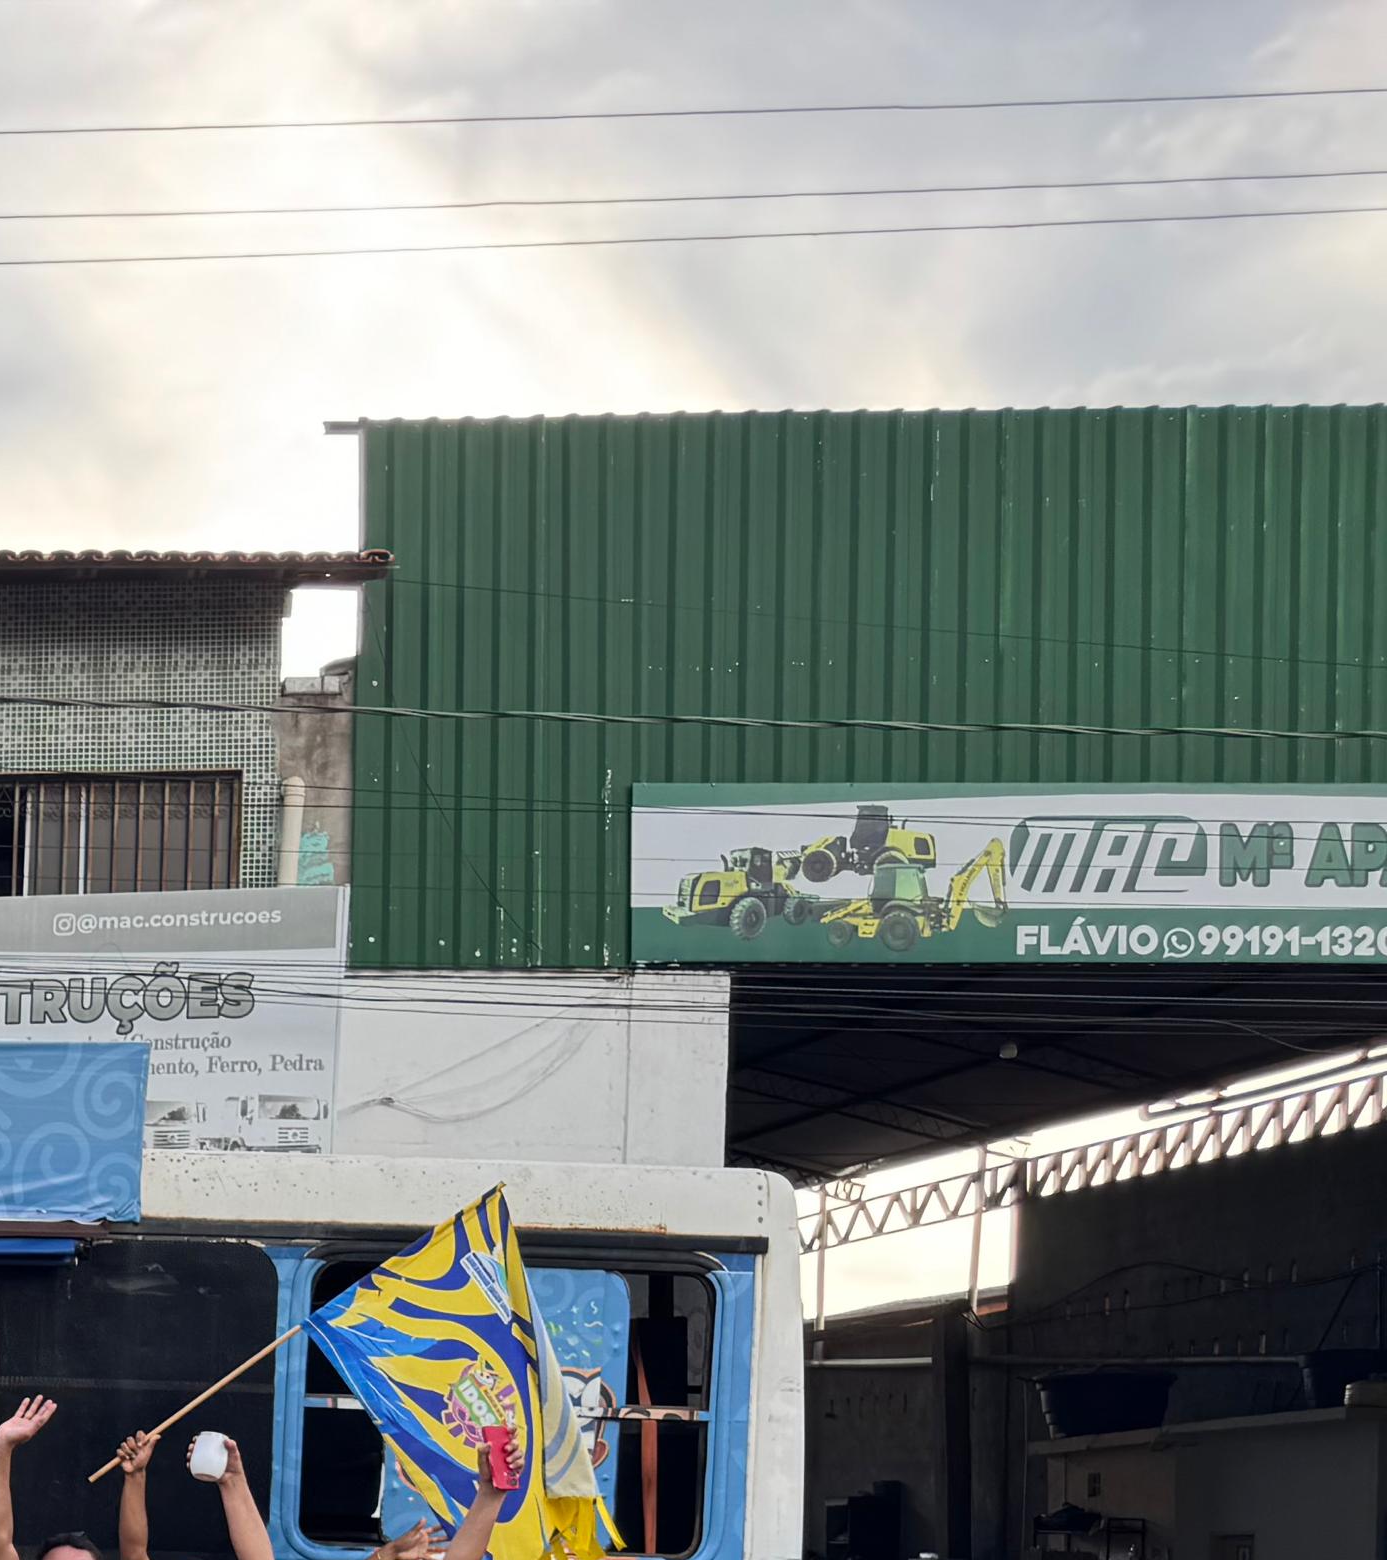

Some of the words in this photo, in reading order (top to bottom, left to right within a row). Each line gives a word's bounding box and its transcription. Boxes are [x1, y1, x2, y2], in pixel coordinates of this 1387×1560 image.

[1305, 822, 1387, 888] AP
[77, 907, 282, 933] @mac.construcoes
[1016, 917, 1159, 955] FLÁVIO
[206, 1056, 263, 1076] Ferro,
[269, 1054, 325, 1072] Pedra
